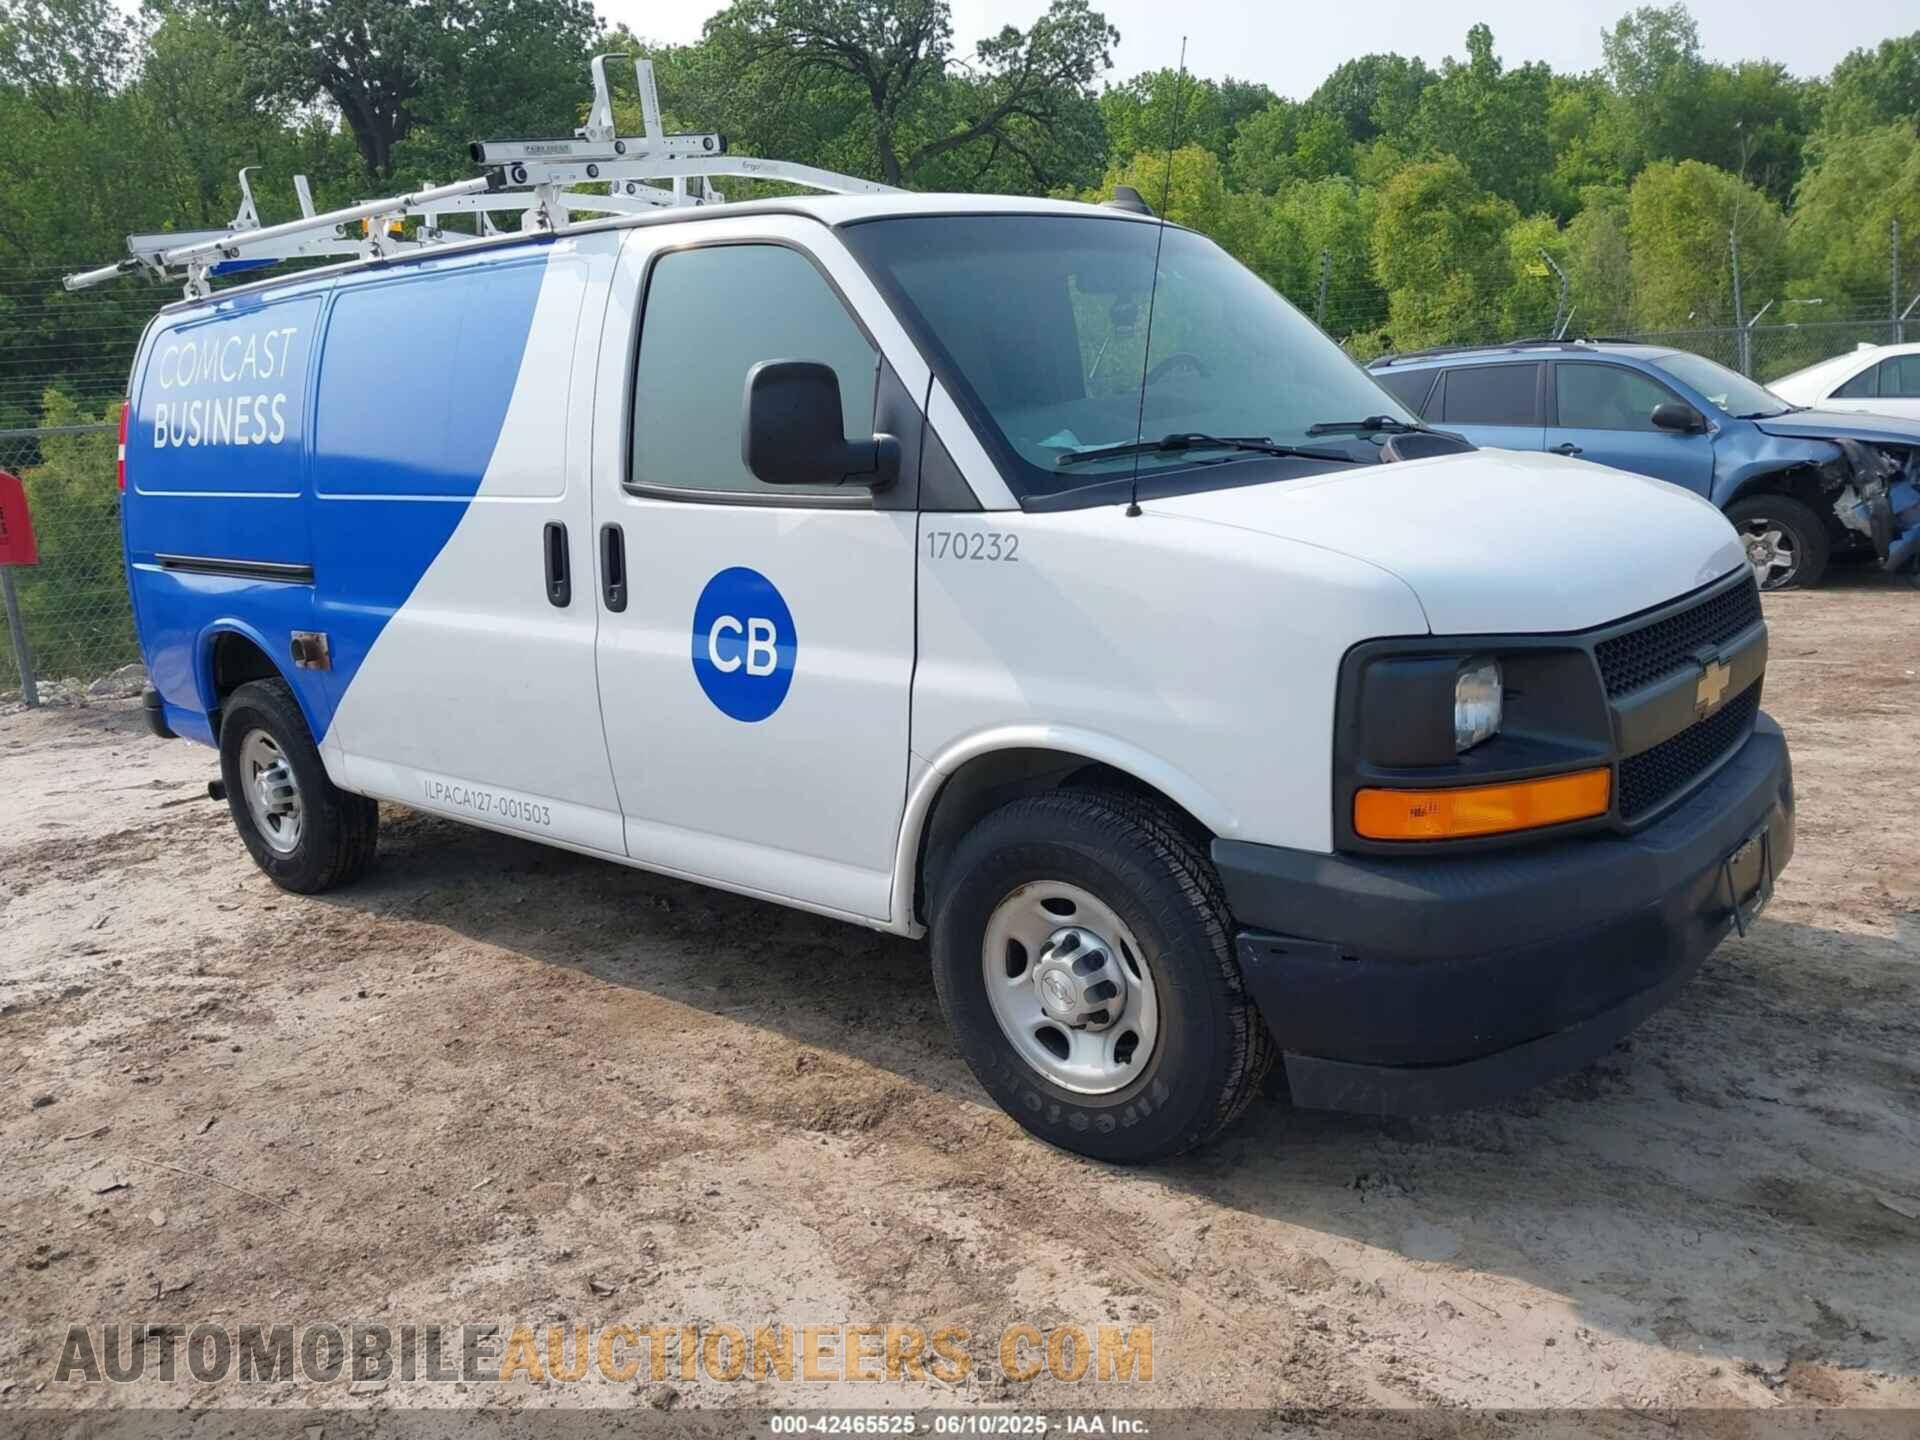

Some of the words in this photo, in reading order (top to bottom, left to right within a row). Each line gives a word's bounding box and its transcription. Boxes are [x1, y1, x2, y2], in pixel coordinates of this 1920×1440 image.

[159, 327, 297, 390] COMCAST
[153, 393, 287, 448] BUSINESS
[926, 532, 1019, 562] 170232
[708, 615, 778, 677] CB
[424, 779, 551, 826] ILPACA127-001503
